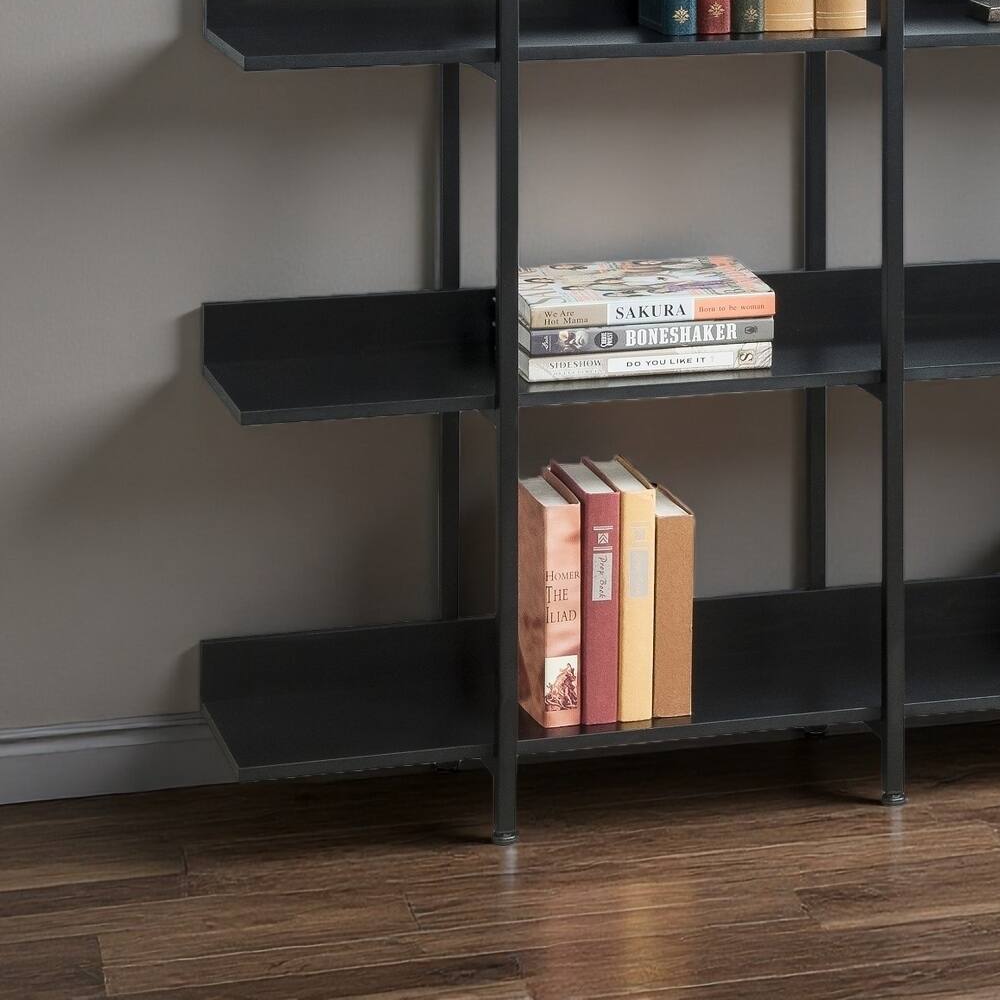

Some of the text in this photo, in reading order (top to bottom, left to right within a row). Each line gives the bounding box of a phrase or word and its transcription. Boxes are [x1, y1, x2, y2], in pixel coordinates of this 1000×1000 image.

[615, 303, 687, 320] SAKURA
[563, 317, 589, 325] Mama
[624, 322, 738, 347] BONESHAKER
[549, 359, 602, 369] SIDESHOW
[626, 356, 706, 369] DO YOU LIKE IT
[545, 569, 581, 582] HOMER
[545, 585, 569, 604] THE
[545, 606, 578, 624] ILIAD
